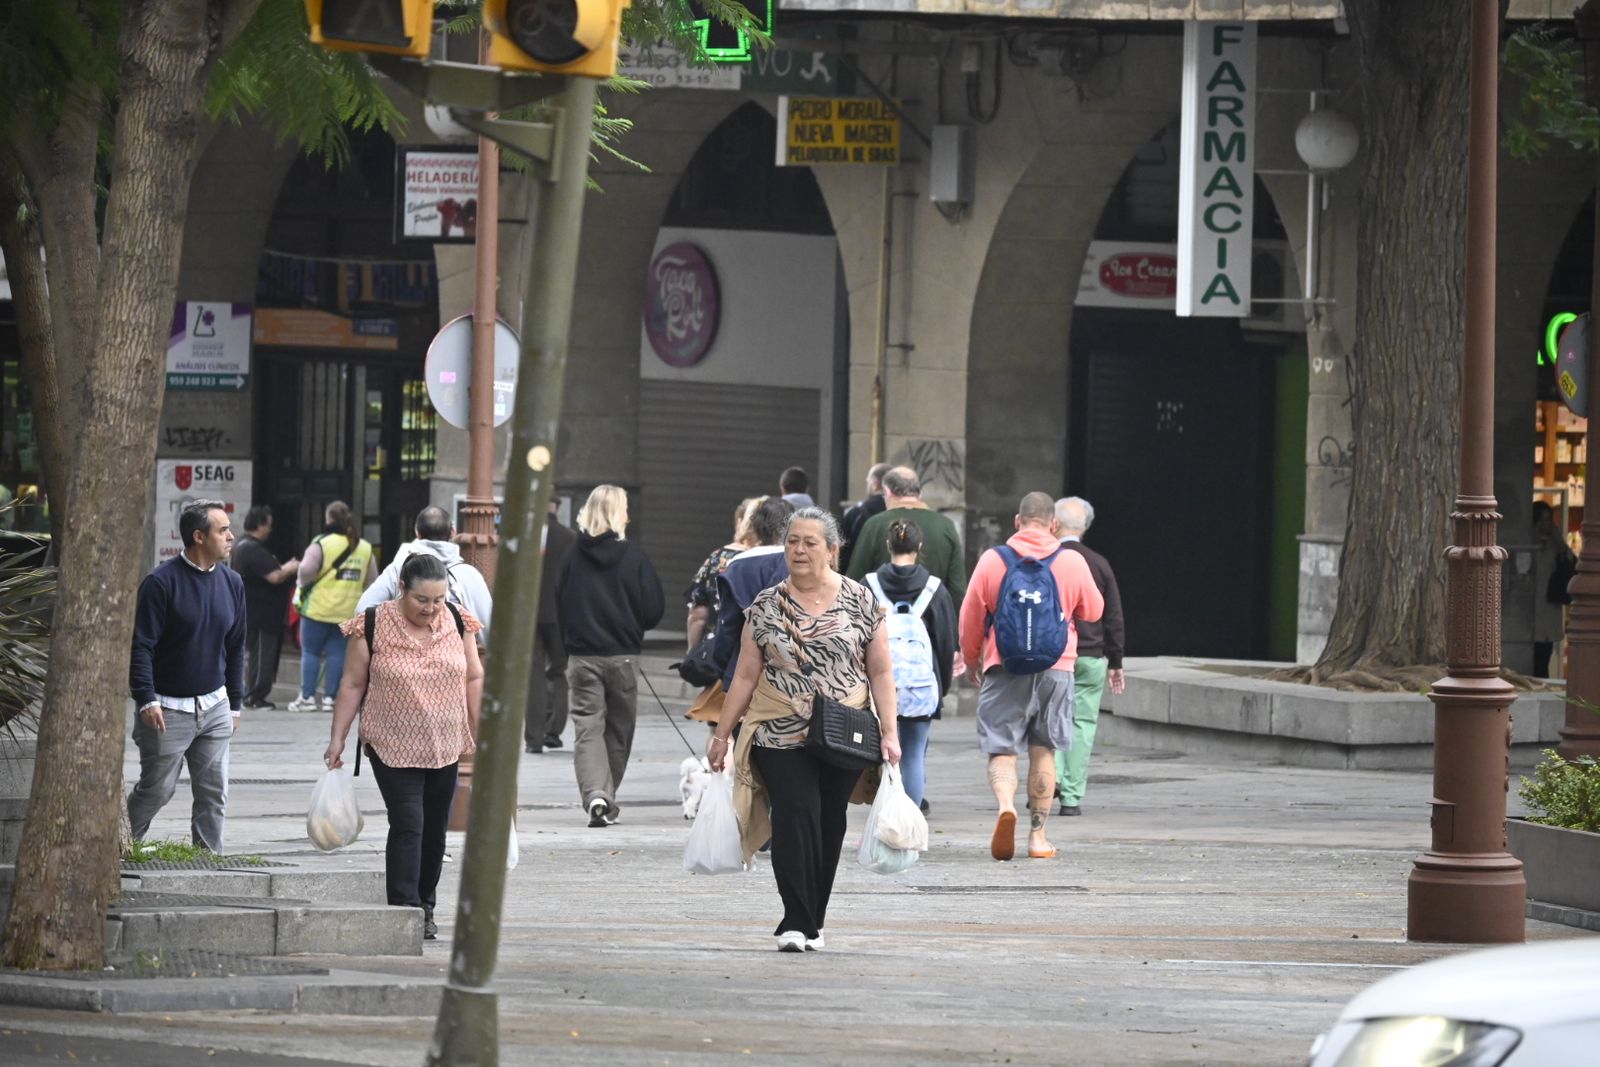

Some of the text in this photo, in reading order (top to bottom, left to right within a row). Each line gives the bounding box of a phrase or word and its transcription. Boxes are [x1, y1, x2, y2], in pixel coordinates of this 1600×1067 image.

[791, 100, 832, 119] PEDRO
[795, 124, 834, 142] NUEVA
[853, 147, 865, 161] DE
[1201, 25, 1247, 305] FARMACIA
[655, 255, 697, 301] Taco
[175, 361, 240, 371] ANÁLISIS CLÍNICOS
[169, 376, 185, 386] 959
[194, 465, 234, 481] SEAG
